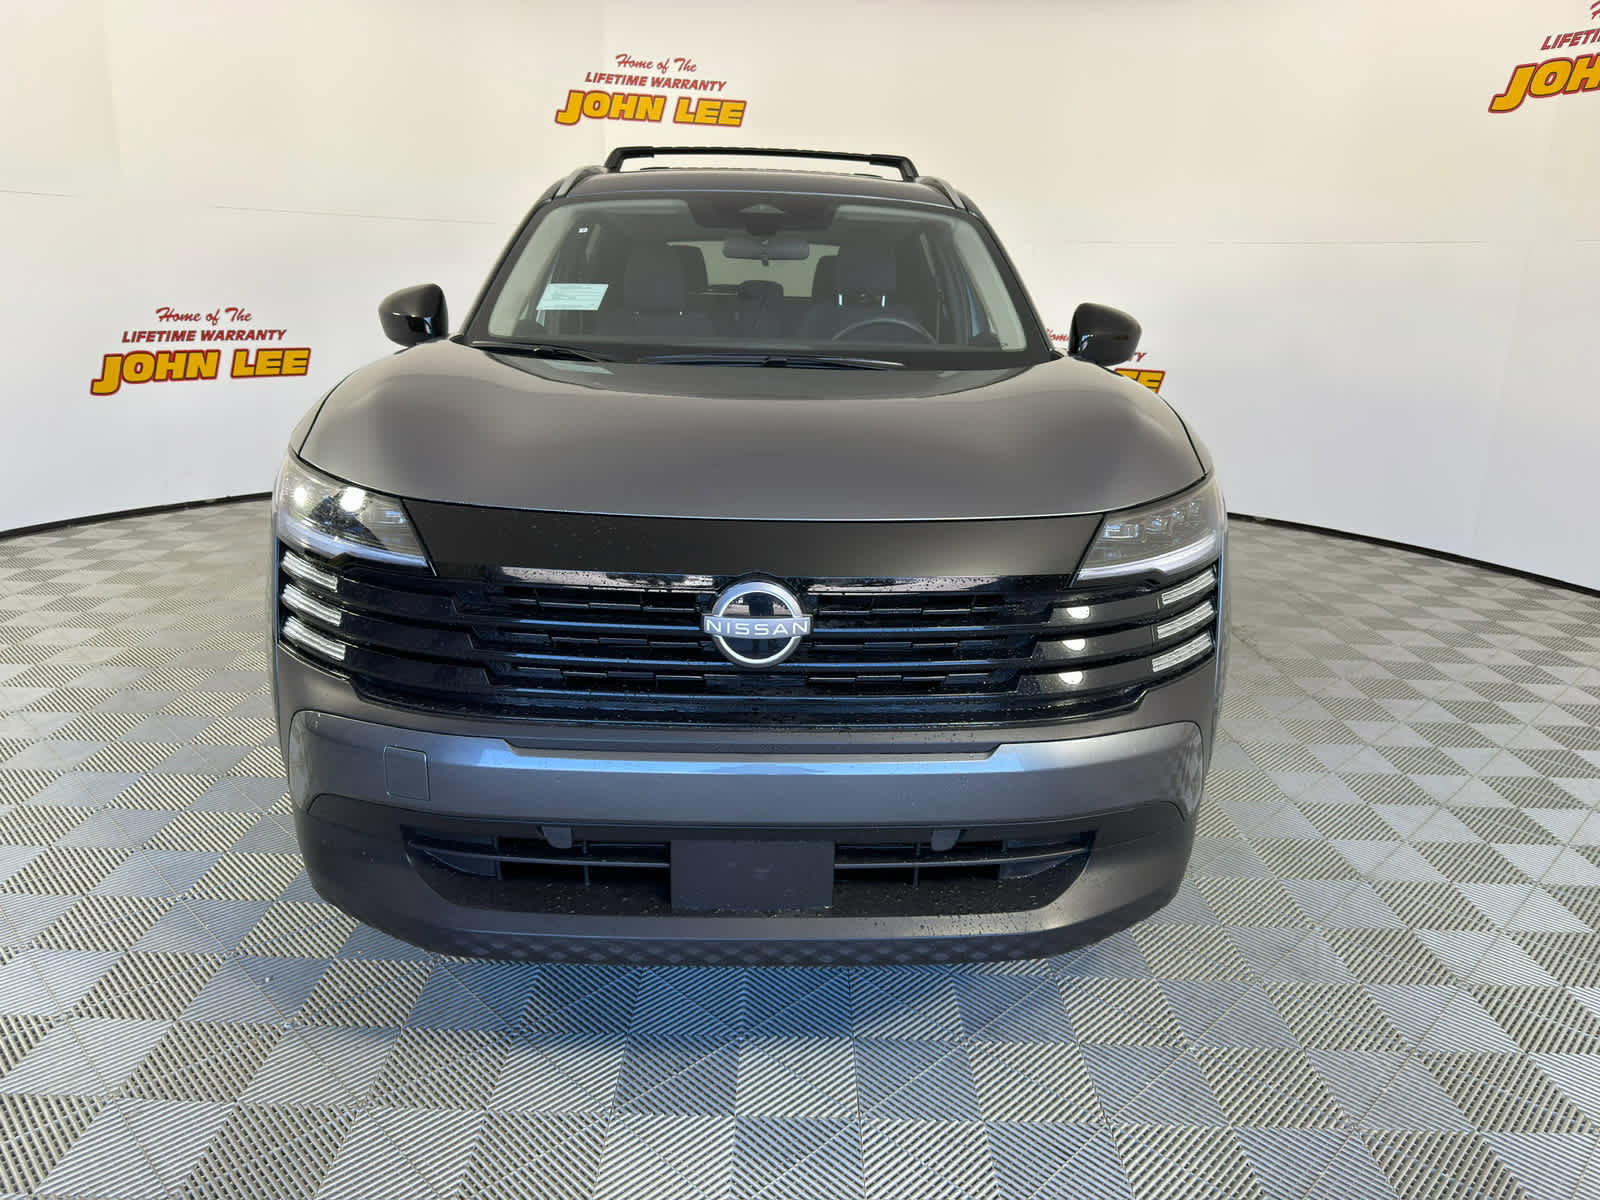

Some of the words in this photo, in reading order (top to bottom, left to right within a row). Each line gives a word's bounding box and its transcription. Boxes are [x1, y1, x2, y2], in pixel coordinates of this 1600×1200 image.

[1541, 28, 1600, 50] LIFETI
[616, 53, 653, 70] Home
[656, 57, 670, 74] of
[674, 57, 697, 73] The
[585, 71, 648, 87] LIFETIME
[650, 76, 727, 92] WARRANTY
[554, 89, 667, 126] JOHN
[673, 96, 747, 128] LEE
[155, 306, 201, 323] Home
[205, 309, 220, 326] of
[224, 307, 252, 322] The
[121, 330, 197, 344] LIFETIME
[200, 329, 287, 342] WARRANTY
[90, 349, 221, 396] JOHN
[230, 347, 311, 378] LEE
[705, 619, 808, 636] NISSAN
